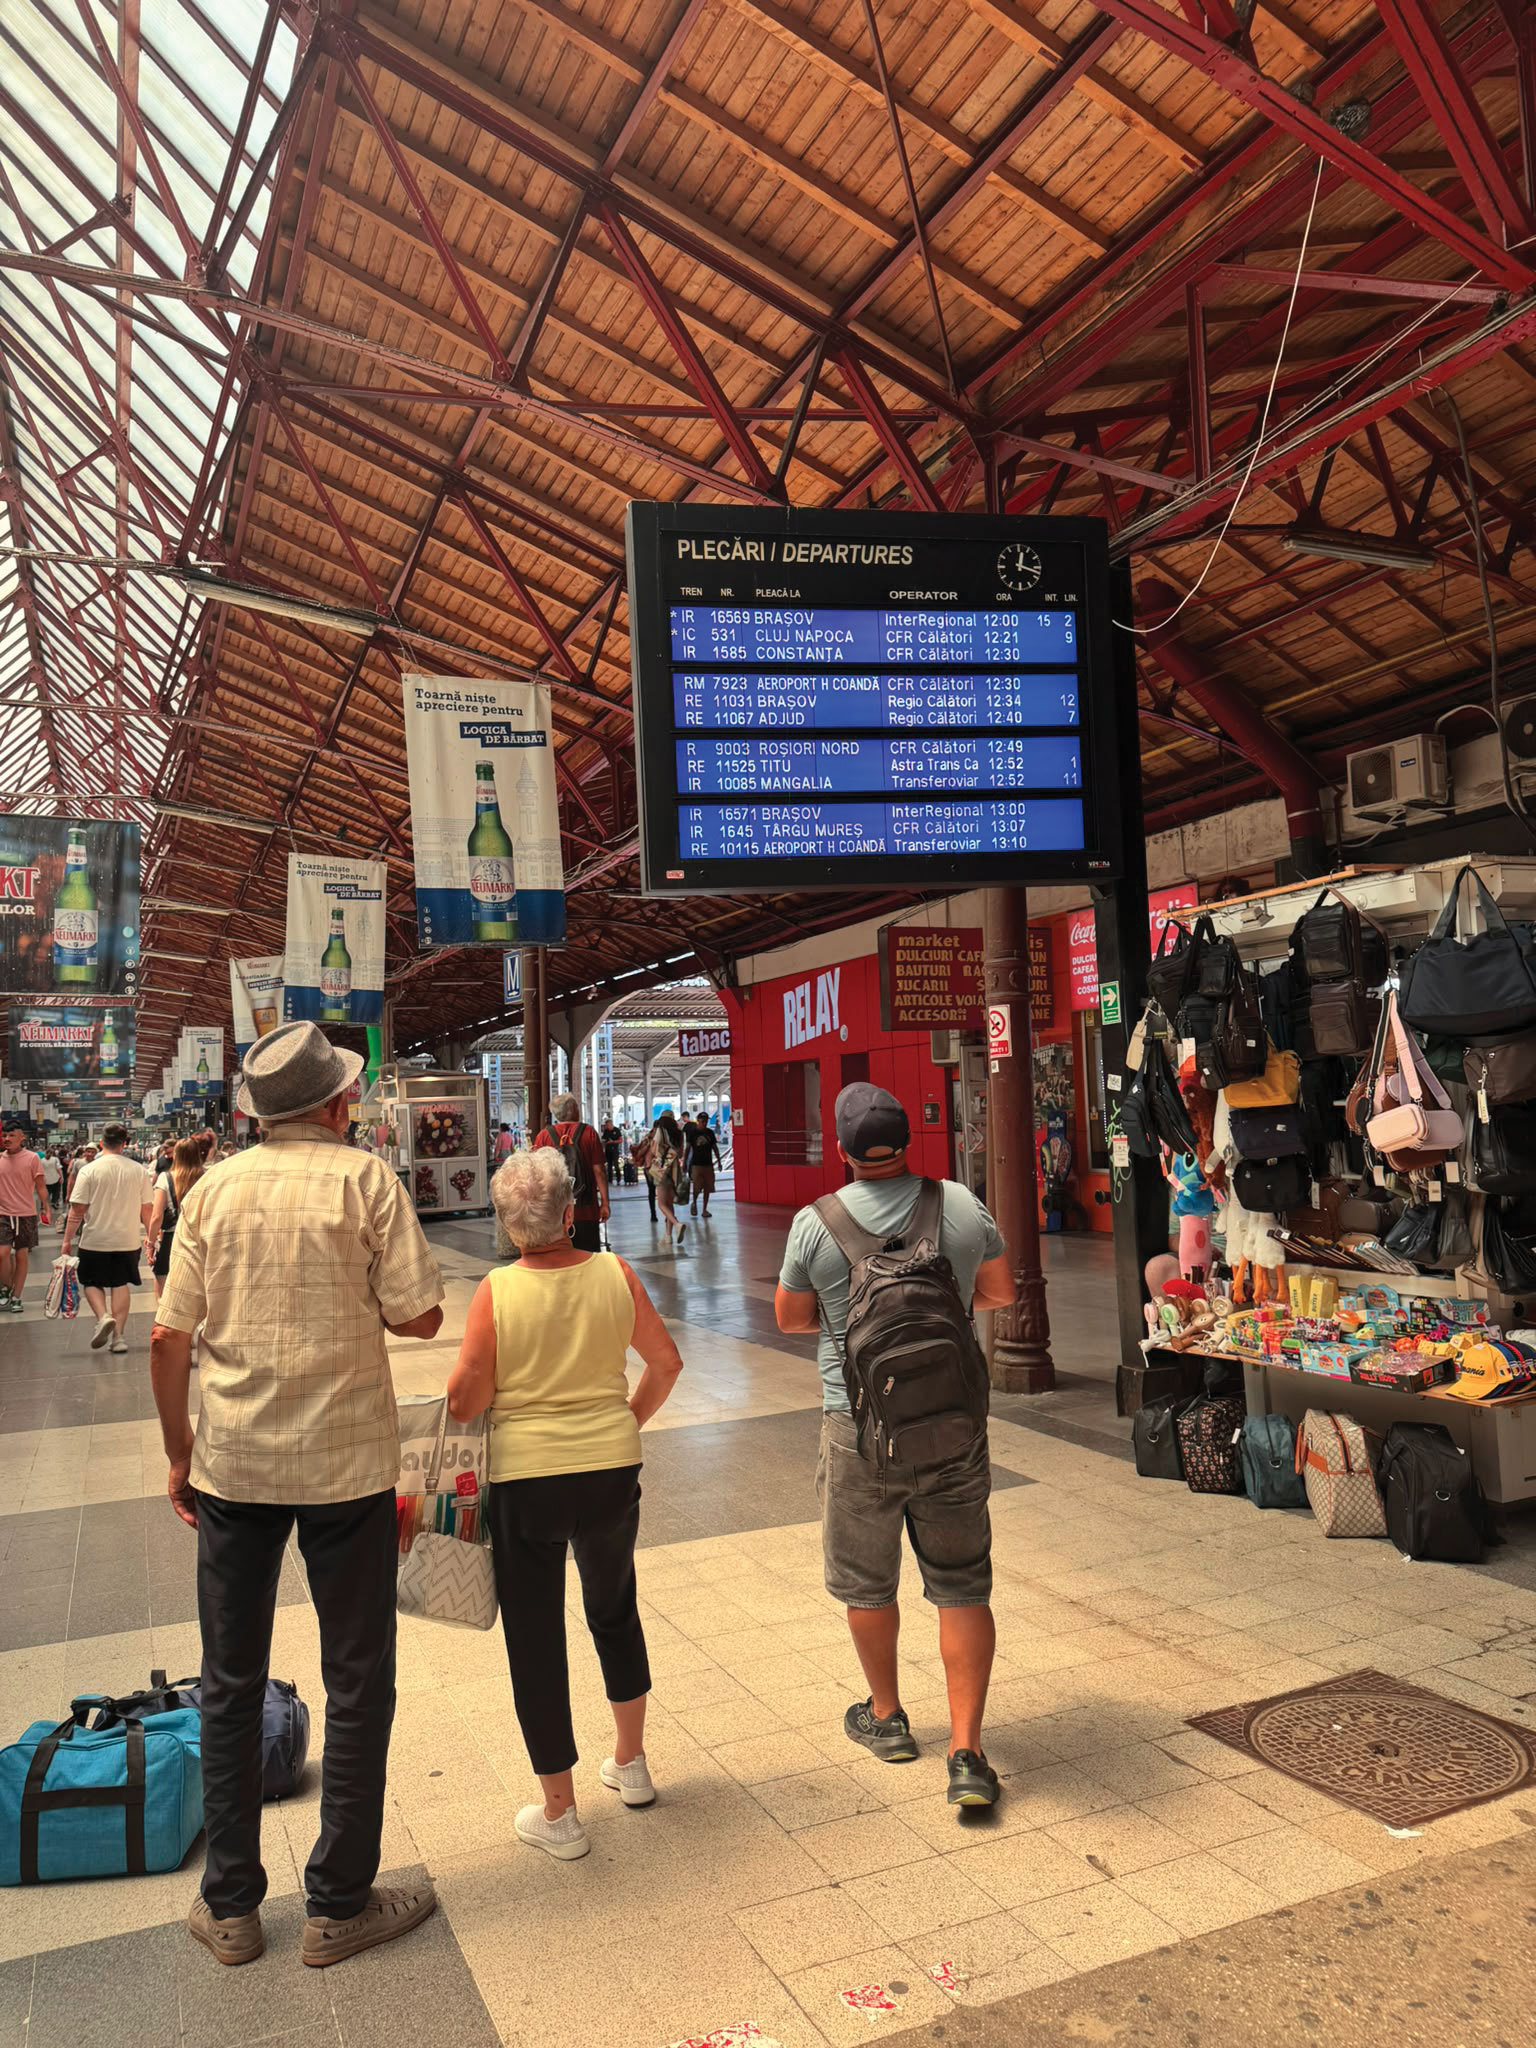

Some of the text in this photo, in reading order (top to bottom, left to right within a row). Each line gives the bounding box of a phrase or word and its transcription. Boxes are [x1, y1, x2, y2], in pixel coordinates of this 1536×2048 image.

[677, 536, 913, 565] PLECĂRI / DEPARTURES
[680, 587, 1078, 602] TREN NR. PLEACĂ LA OPERATOR ORA INT. LIN.
[681, 610, 1072, 629] IR 16569 BRAȘOV InterRegional 12:00 15 2
[682, 628, 1073, 644] IC 531 CLUJ NAPOCA CFR Călători 12:21 9
[683, 645, 1020, 663] IR 1585 CONSTANȚA CFR Călători 12:30
[684, 676, 1021, 691] RM 7923 AEROPORT H COANDĂ CFR Călători 12:30
[414, 688, 496, 705] Toarnă niște
[685, 694, 1076, 710] RE 11031 BRAȘOV Regio Călători 12:34 12
[416, 701, 524, 717] apreciere pentru
[686, 711, 1076, 727] RE 11067 ADJUD Regio Călători 12:40 7
[463, 725, 507, 735] LOGICA
[485, 732, 545, 744] DE BĂRBAT
[687, 740, 1023, 758] R 9003 ROȘIORI NORD CFR Călători 12:49
[687, 756, 1077, 773] RE 11525 TITU Astra Trans Ca 12:52 1
[688, 773, 1078, 790] IR 10085 MANGALIA Transferoviar 12:52 11
[689, 802, 1026, 823] IR 16571 BRAȘOV InterRegional 13:00
[690, 819, 1026, 839] IR 1645 TÂRGU MUREȘ CFR Călători 13:07
[691, 836, 1027, 856] RE 10115 AEROPORT H COANDĂ Transferoviar 13:10
[339, 873, 368, 881] pentru
[899, 933, 960, 947] market
[896, 949, 953, 962] DULCIURI
[507, 956, 520, 991] M
[896, 964, 951, 977] BAUTURI
[1072, 965, 1094, 975] CAFEA
[896, 979, 948, 992] JUCARII
[894, 994, 953, 1006] ARTICOLE
[783, 967, 840, 1050] RELAY
[18, 1017, 94, 1041] NEUMARKT
[681, 1030, 730, 1055] tabac
